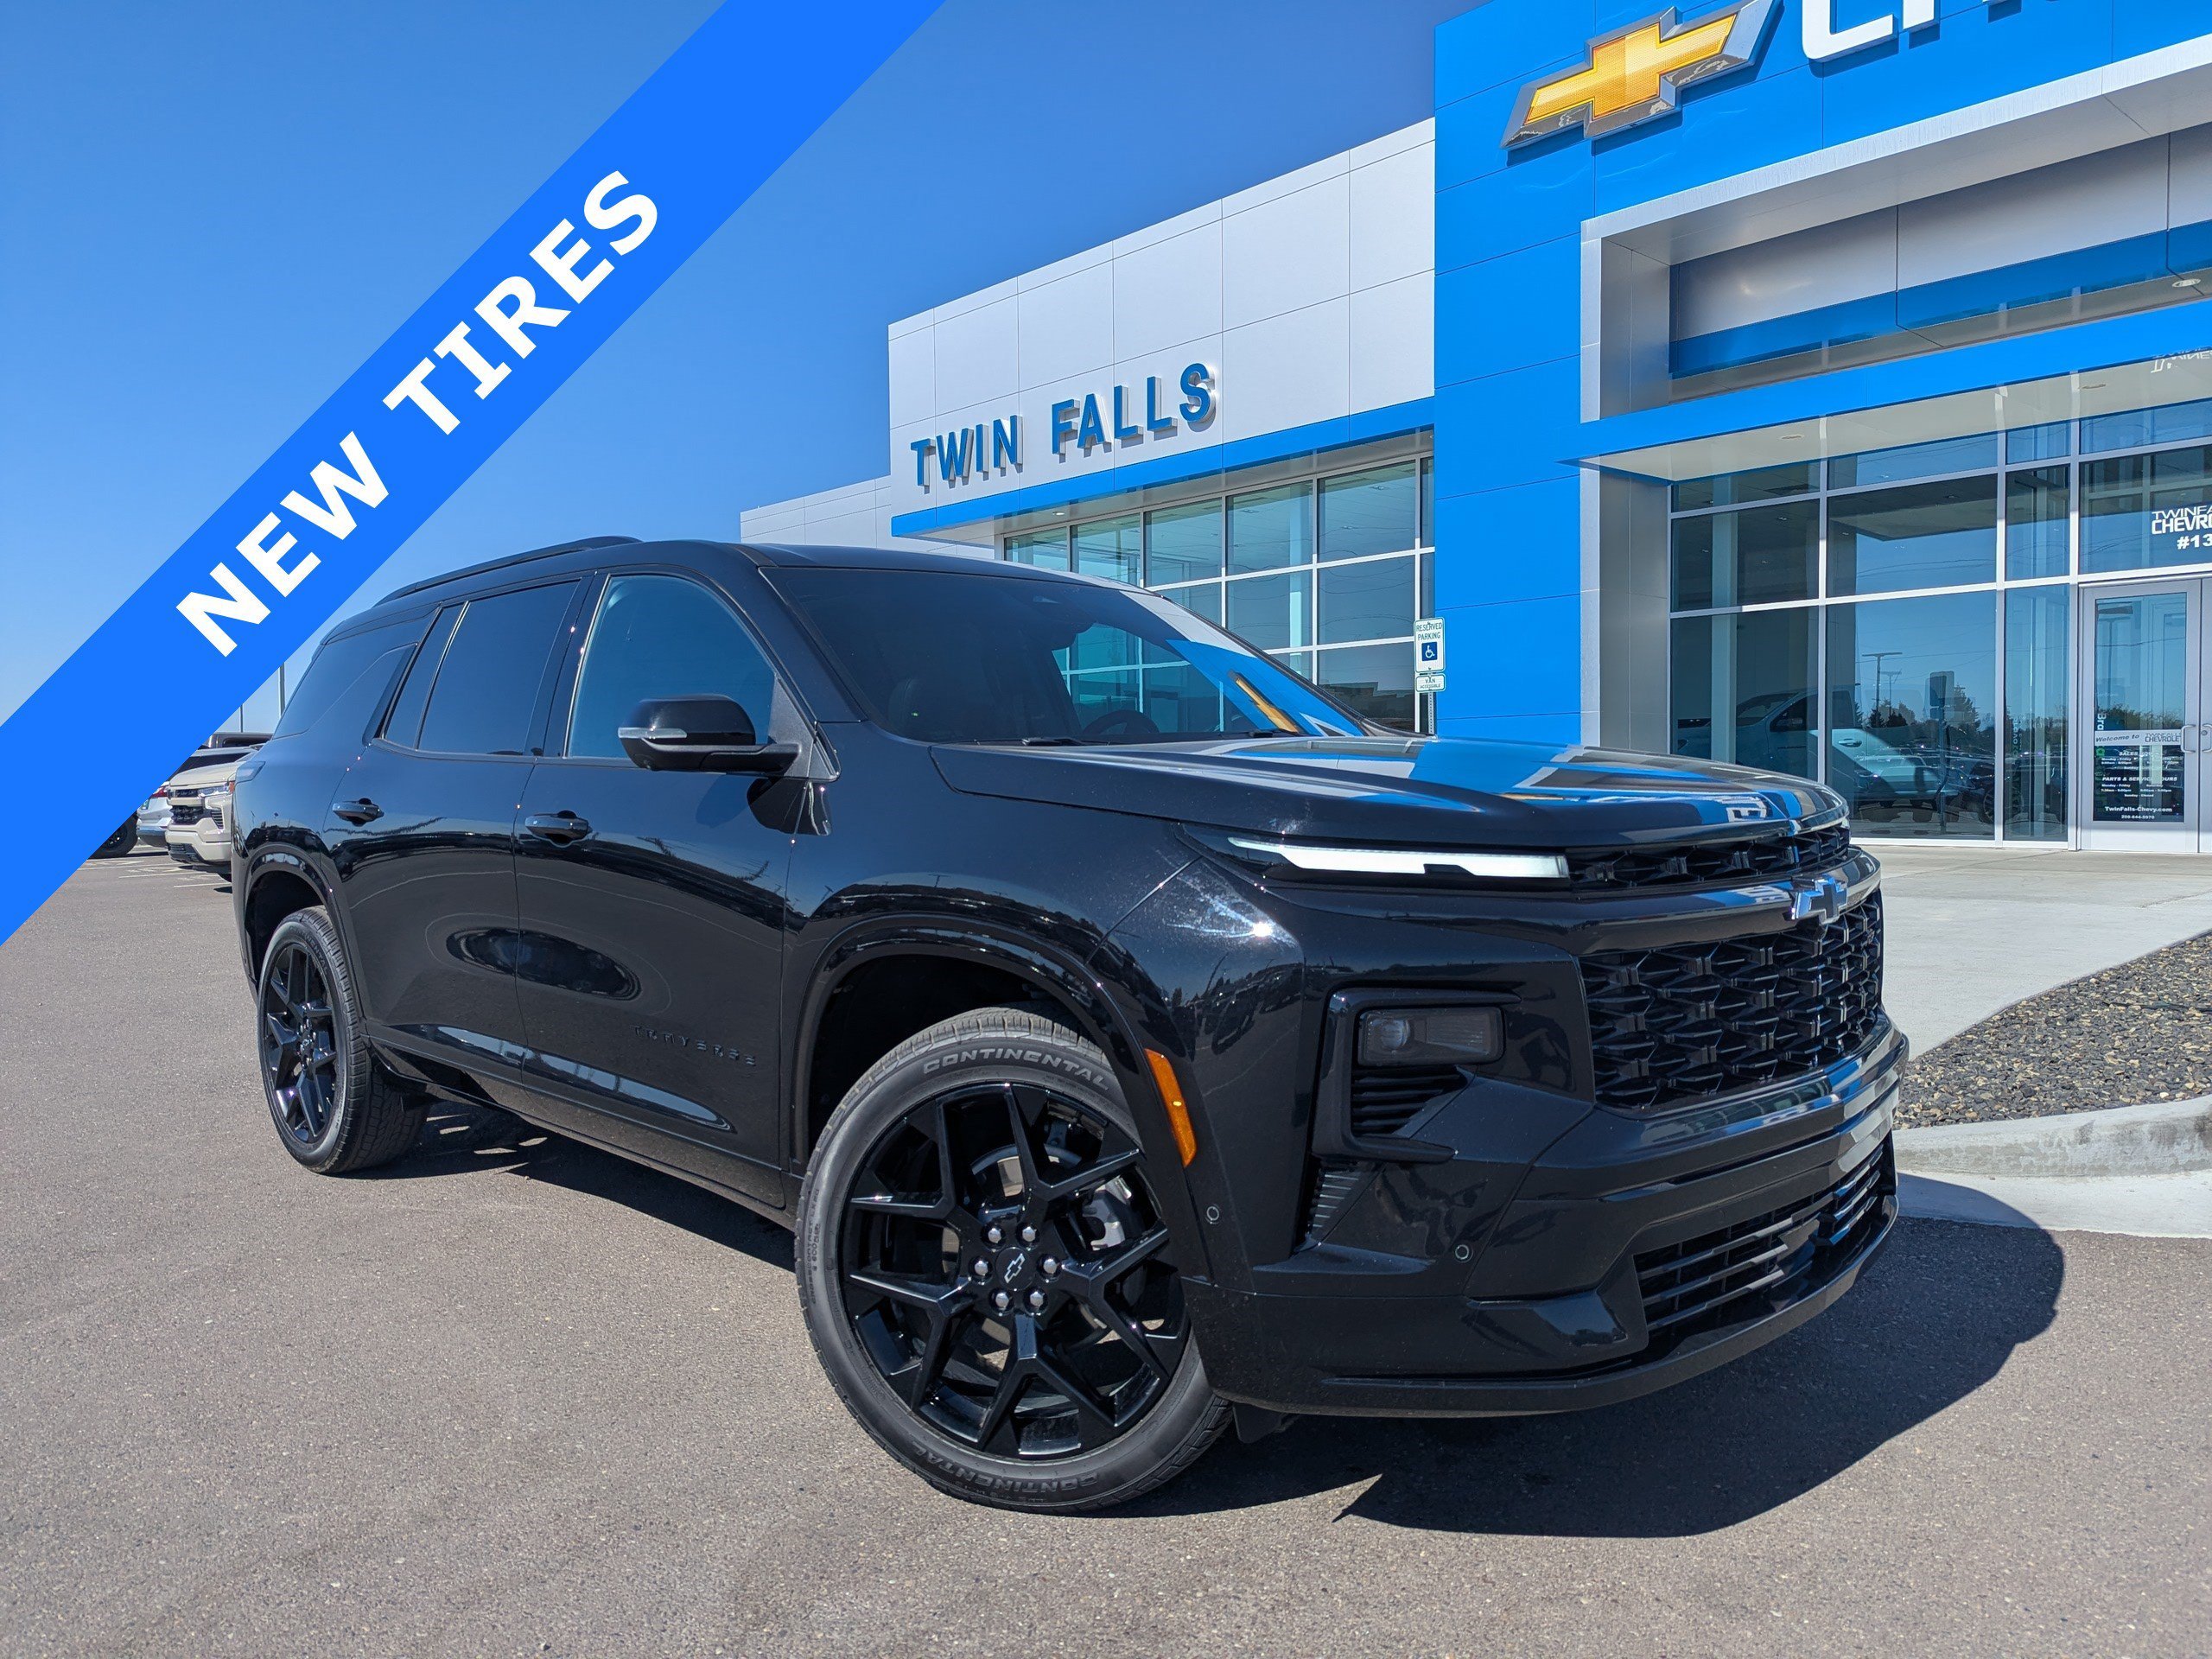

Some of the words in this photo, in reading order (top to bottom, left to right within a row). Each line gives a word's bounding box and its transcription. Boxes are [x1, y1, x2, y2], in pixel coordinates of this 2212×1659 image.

[910, 415, 1023, 487] TWIN
[1052, 363, 1217, 456] FALLS
[1416, 622, 1442, 632] RESERVED
[1418, 632, 1441, 640] PARKING
[923, 1048, 1109, 1091] CONTINENTAL
